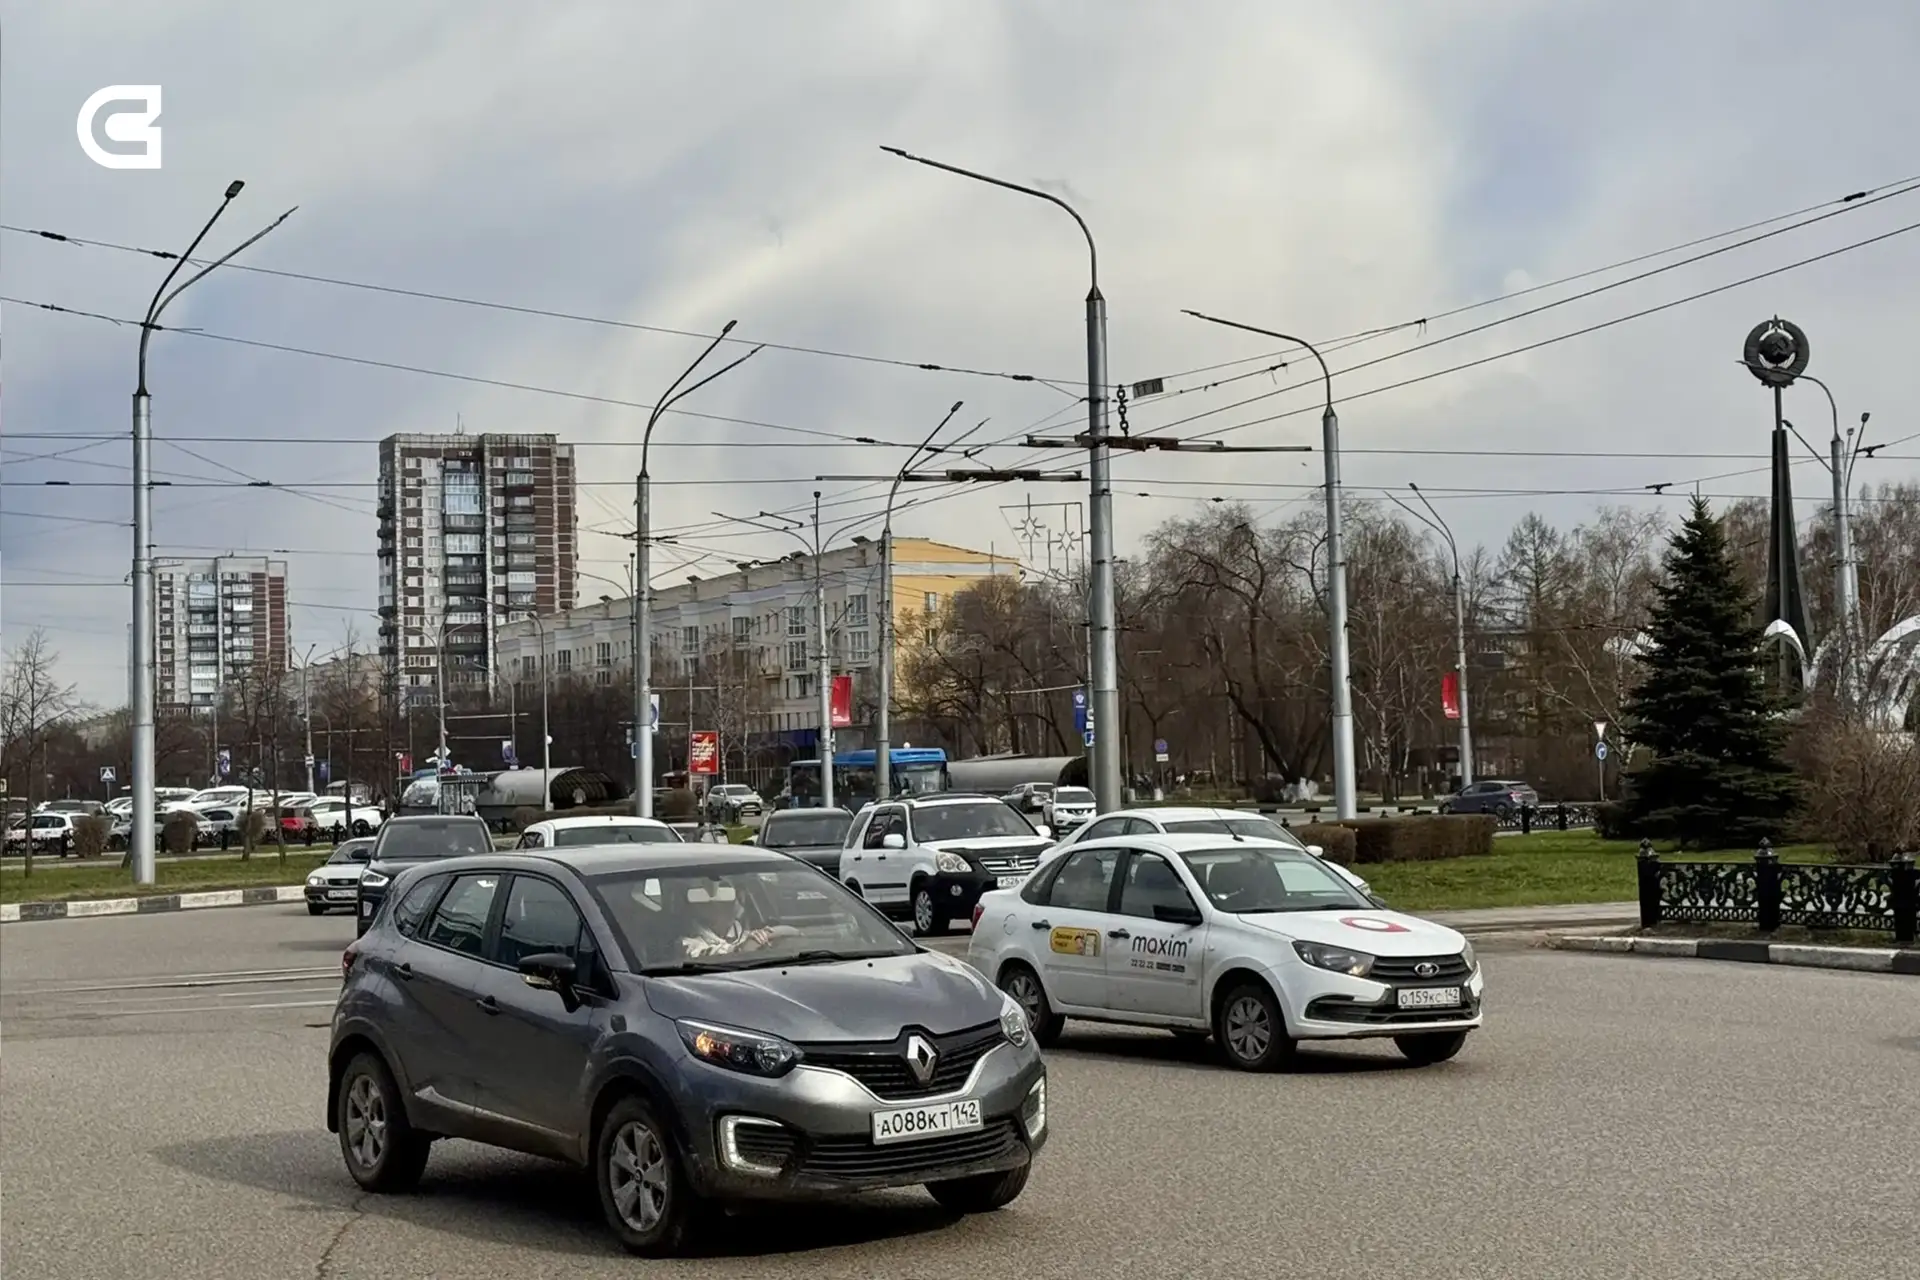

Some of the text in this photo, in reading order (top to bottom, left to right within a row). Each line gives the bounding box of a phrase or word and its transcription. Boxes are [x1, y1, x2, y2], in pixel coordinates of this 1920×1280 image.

[1132, 934, 1188, 959] maxim
[881, 1102, 976, 1136] А088КТ 142
